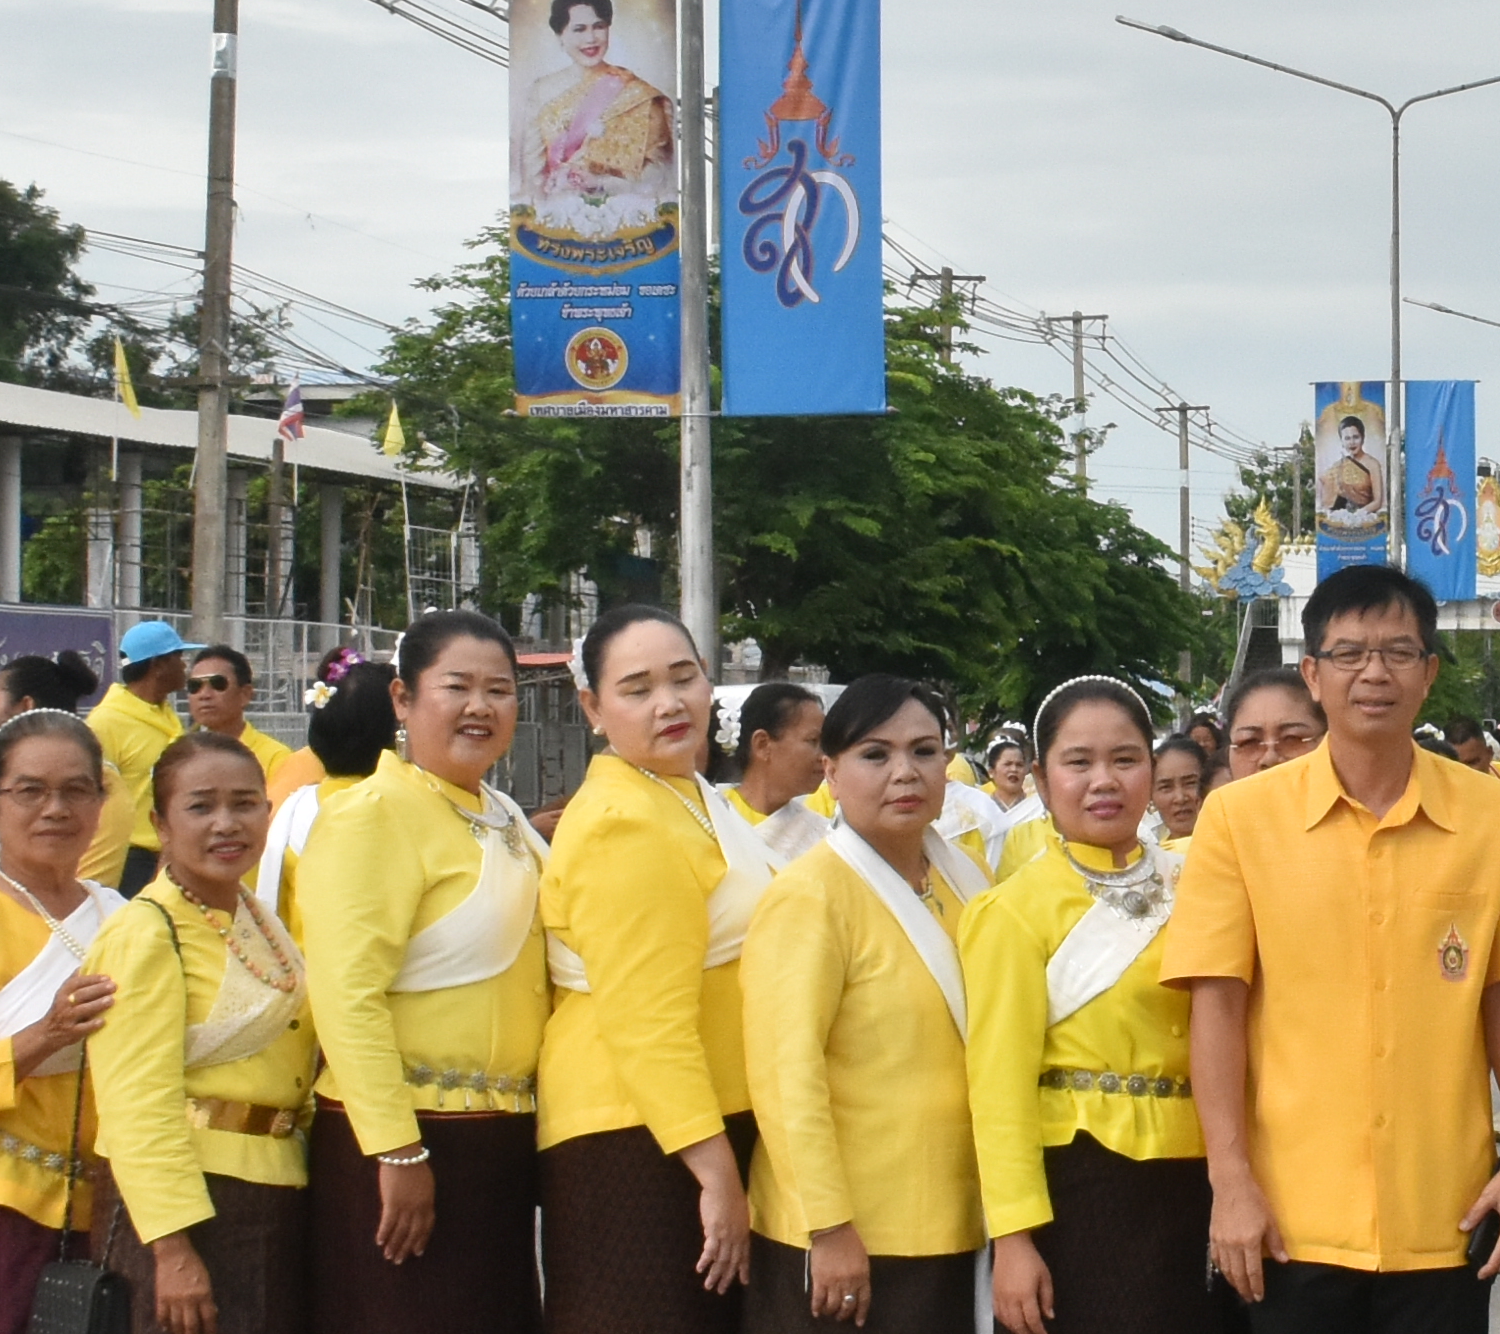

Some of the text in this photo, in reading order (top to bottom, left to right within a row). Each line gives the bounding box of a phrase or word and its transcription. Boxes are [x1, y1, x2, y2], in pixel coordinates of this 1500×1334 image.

[537, 234, 657, 263] ทรงพระเจริญ
[529, 399, 669, 417] เทศบาลเมืองมหาสารคาม
